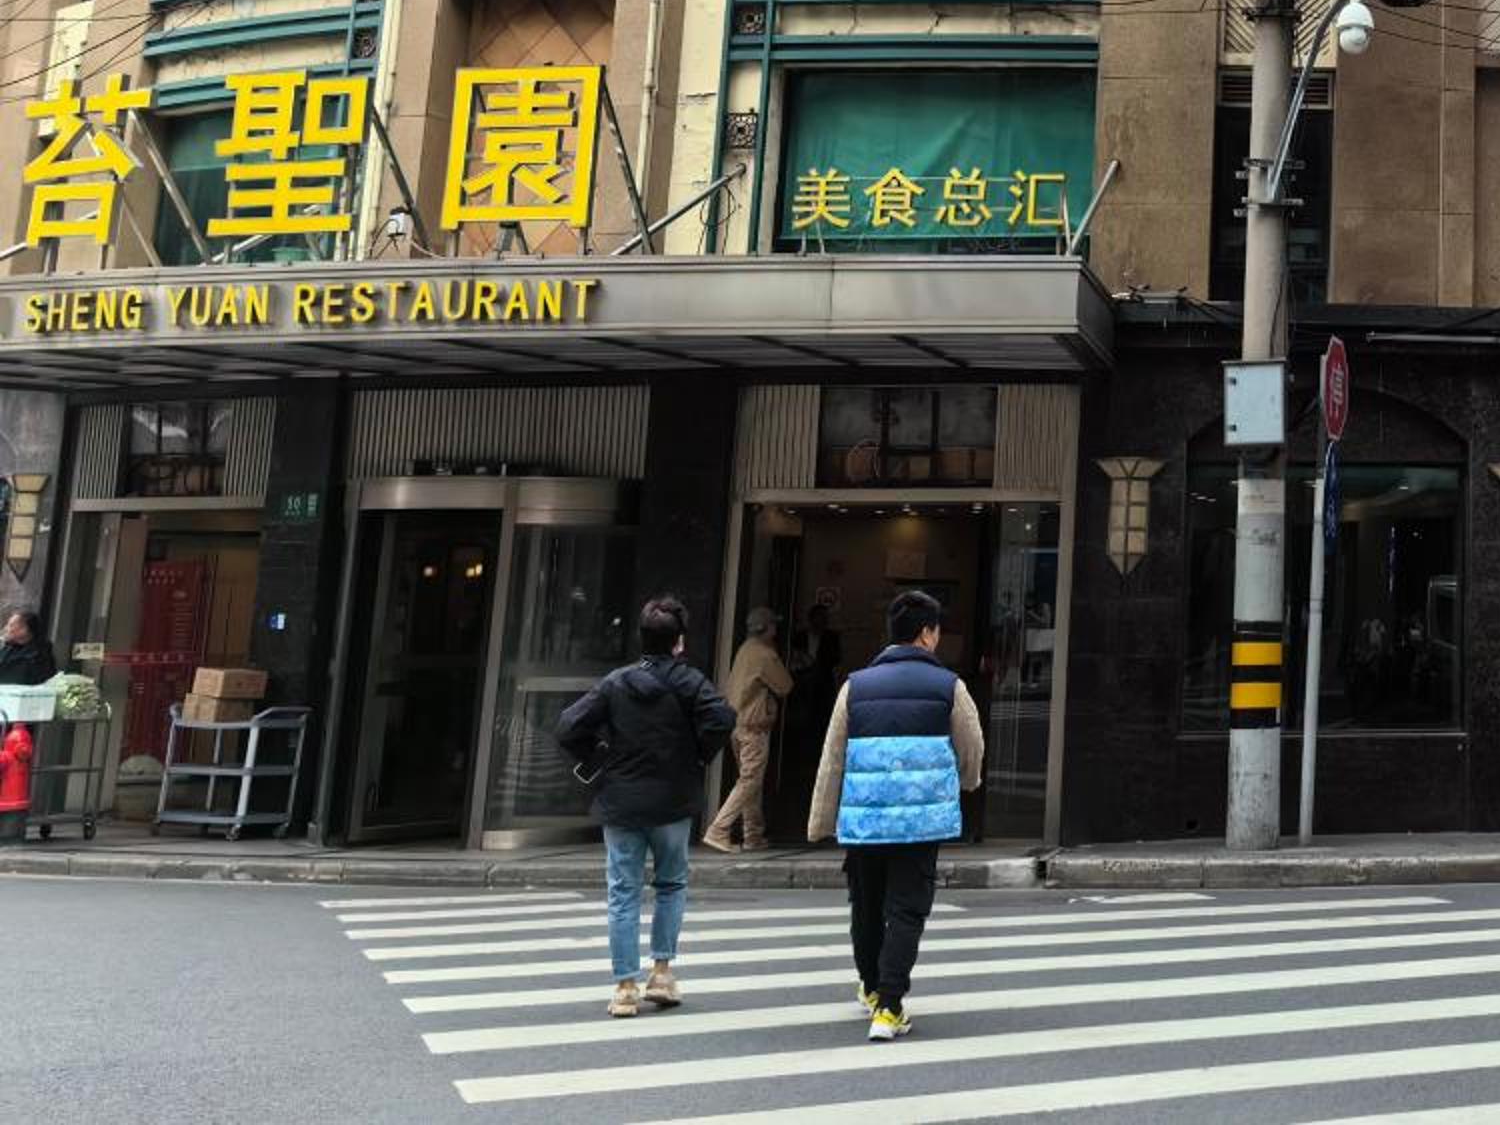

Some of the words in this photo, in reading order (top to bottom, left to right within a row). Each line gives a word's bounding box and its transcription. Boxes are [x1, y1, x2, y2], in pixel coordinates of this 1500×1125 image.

[792, 167, 1067, 229] 美食总汇
[23, 287, 146, 333] SHENG
[165, 282, 271, 327] YUAN
[296, 279, 599, 325] RESTAURANT
